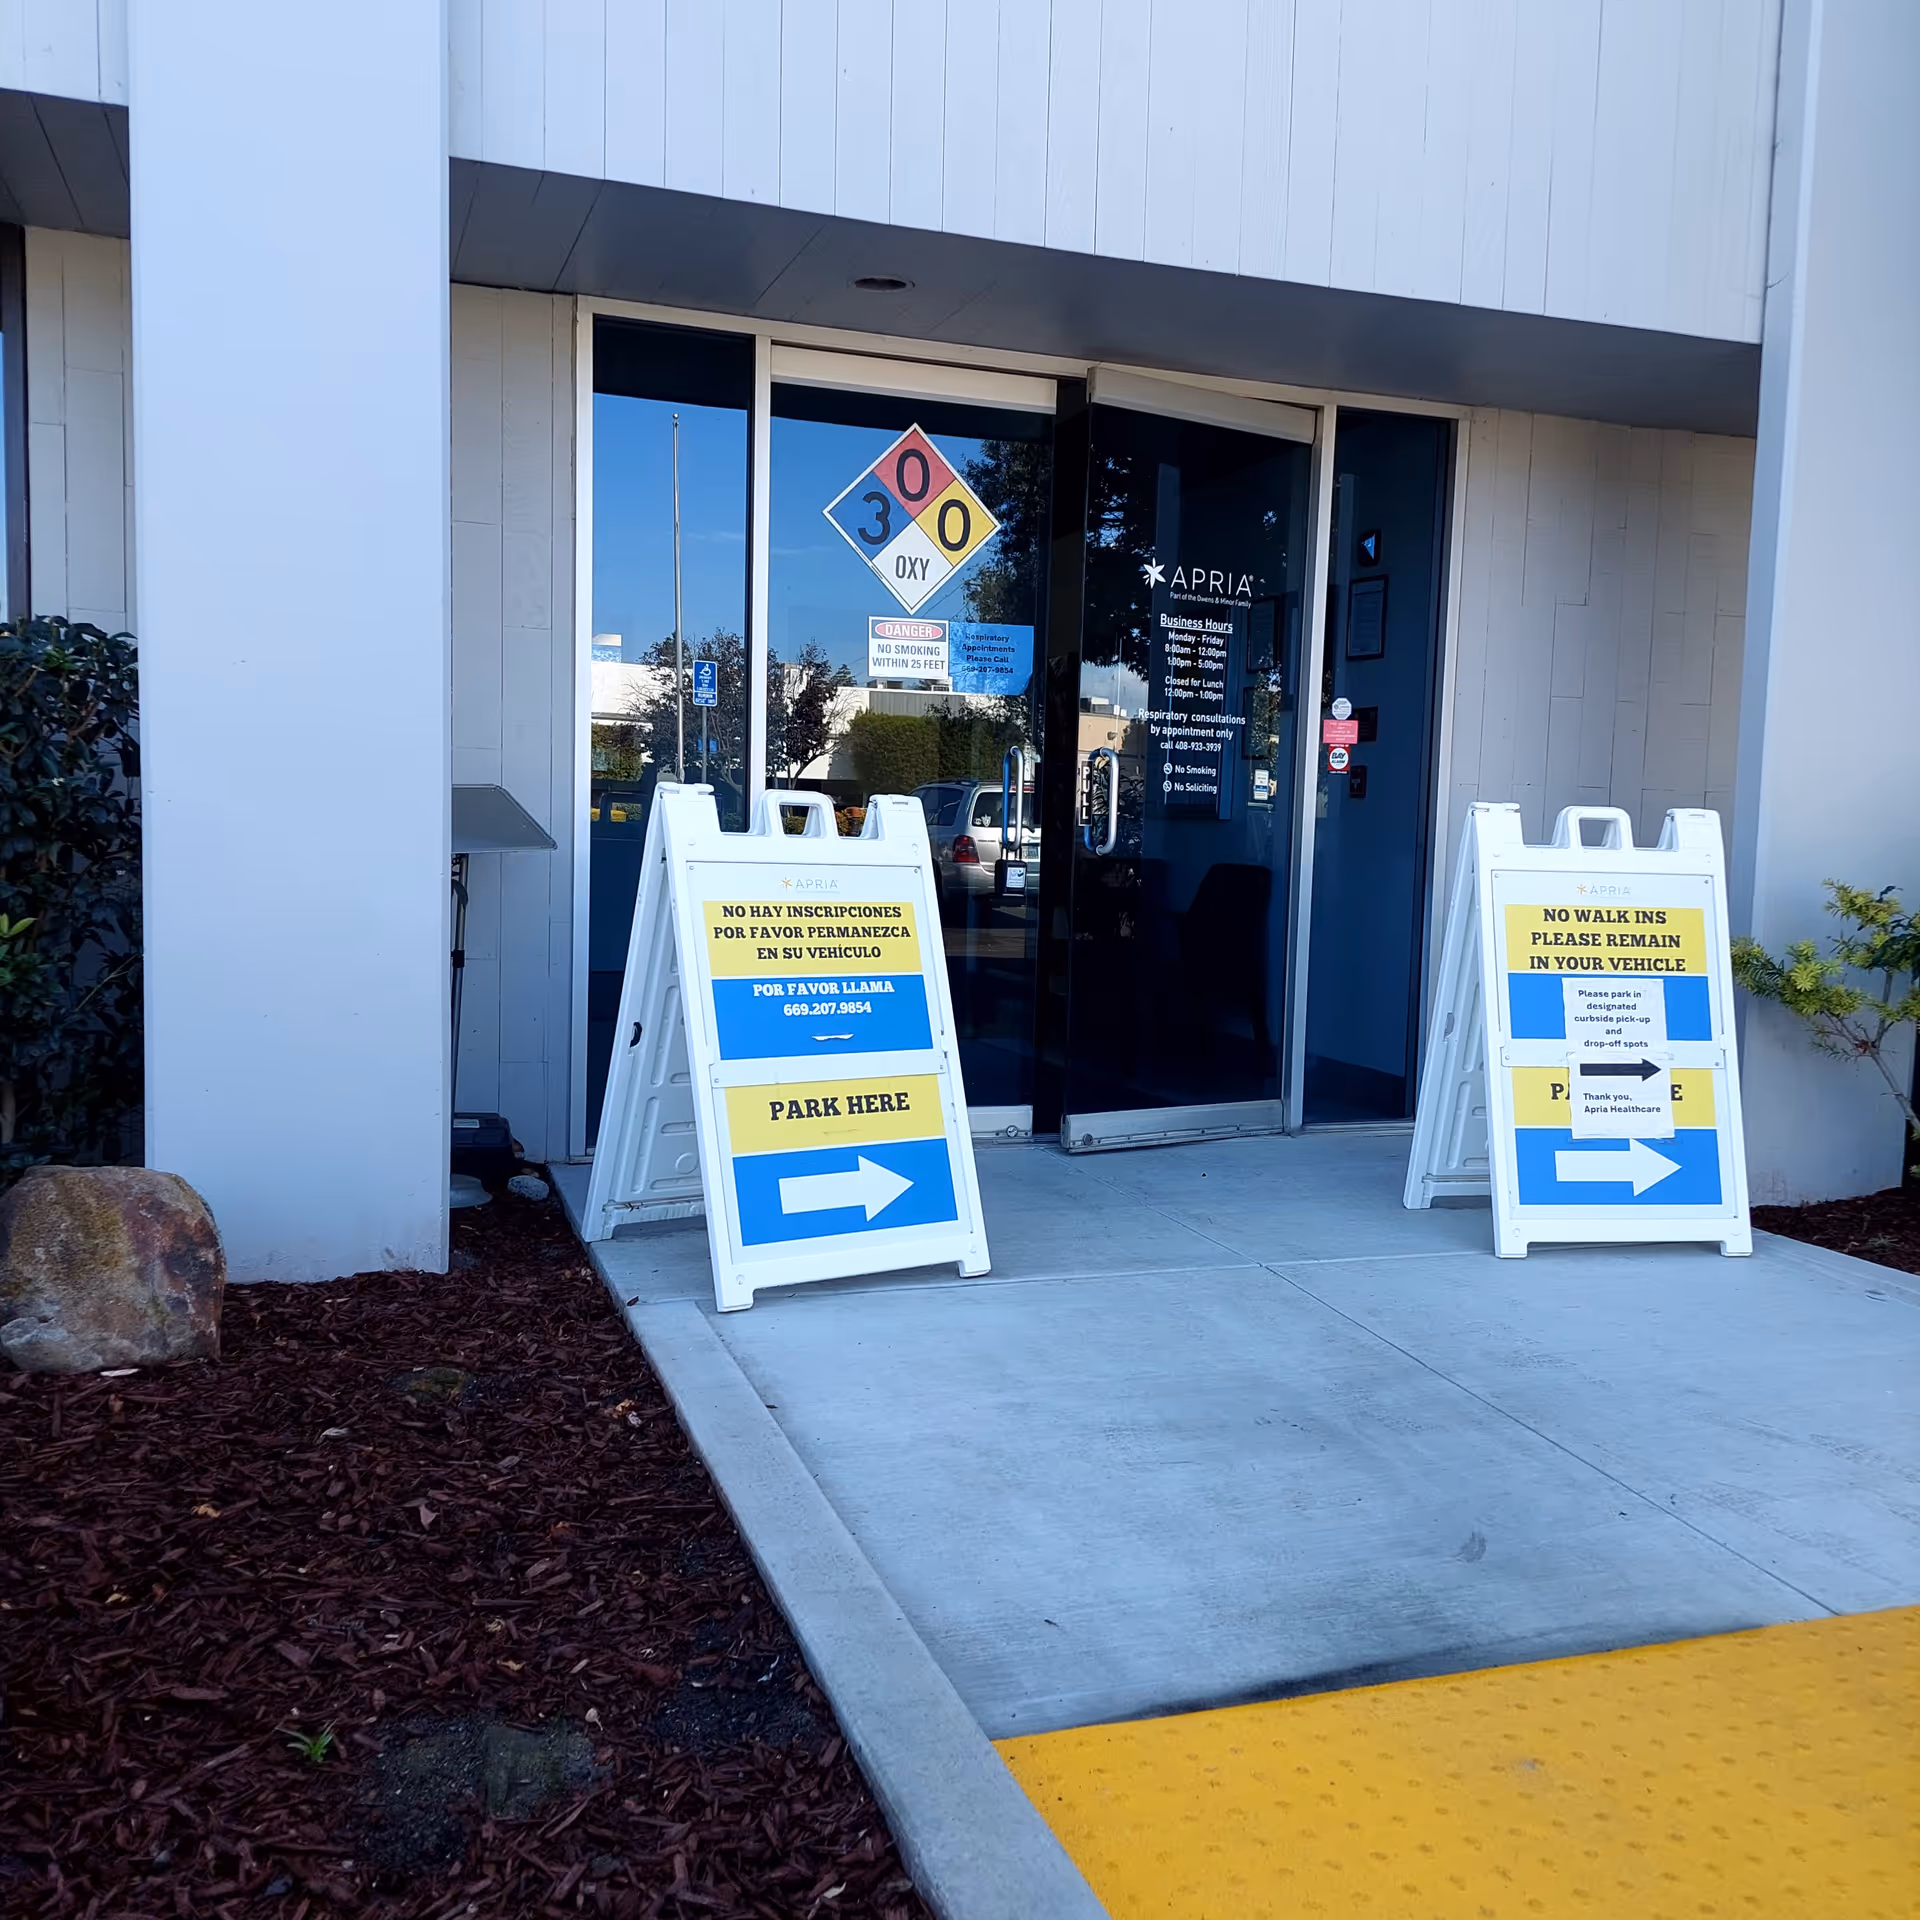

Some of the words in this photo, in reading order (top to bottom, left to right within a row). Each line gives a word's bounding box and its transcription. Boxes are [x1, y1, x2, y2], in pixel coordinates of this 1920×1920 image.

[896, 448, 930, 502] 0
[858, 491, 891, 546] 3
[938, 499, 970, 552] 0
[896, 555, 930, 581] OXY
[1170, 592, 1181, 600] Part
[1235, 599, 1252, 609] Family
[1160, 614, 1202, 628] Business
[1206, 618, 1233, 632] Hours
[886, 624, 932, 638] DANGER
[1168, 631, 1196, 644] Monday
[1202, 635, 1224, 646] Friday
[877, 644, 892, 655] NO
[894, 644, 940, 656] SMOKING
[962, 644, 1016, 653] Appointments
[1165, 644, 1191, 654] 8:00am
[1198, 647, 1226, 658] 12:00pm
[872, 656, 908, 668] WITHIN
[910, 658, 922, 669] 25
[924, 659, 946, 670] FEET
[1167, 657, 1192, 668] 1:00pm
[1198, 660, 1224, 671] 5:00pm
[1165, 676, 1189, 686] Closed
[1190, 678, 1200, 686] for
[1202, 679, 1223, 688] Lunch
[1164, 688, 1194, 699] 12:00pm
[1200, 690, 1223, 701] 1:00pm
[1138, 708, 1188, 723] Respiratory
[1191, 713, 1246, 724] consultations
[1150, 724, 1160, 736] by
[1162, 726, 1214, 737] appointment
[1216, 728, 1234, 740] only
[1160, 741, 1173, 749] call
[1175, 741, 1221, 752] 408-933-3939
[1175, 765, 1185, 774] No
[1186, 766, 1216, 777] Smoking
[1082, 766, 1090, 819] PULL
[1174, 783, 1184, 791] No
[1186, 783, 1217, 794] Soliciting
[722, 905, 746, 918] NO
[750, 905, 782, 918] HAY
[786, 906, 902, 918] INSCRIPCIONES
[1543, 908, 1570, 922] NO
[1574, 909, 1630, 924] WALK
[1634, 910, 1666, 924] INS
[714, 926, 746, 939] POR
[750, 926, 803, 938] FAVOR
[807, 926, 911, 938] PERMANEZCA
[1531, 932, 1601, 946] PLEASE
[1606, 934, 1681, 948] REMAIN
[757, 948, 778, 960] EN
[782, 947, 802, 959] SU
[807, 944, 881, 958] VEHÍCULO
[1529, 956, 1550, 969] IN
[1554, 957, 1604, 970] YOUR
[1608, 958, 1686, 972] VEHICLE
[753, 984, 784, 997] POR
[787, 982, 839, 996] FAVOR
[842, 980, 895, 994] LLAMA
[1578, 990, 1609, 998] Please
[1611, 990, 1631, 1000] park
[1633, 990, 1642, 998] in
[783, 1001, 872, 1016] 669.207.9854
[1586, 1002, 1637, 1012] designated
[1574, 1015, 1614, 1023] curbside
[1616, 1015, 1651, 1025] pick-up
[1605, 1027, 1622, 1035] and
[1584, 1040, 1622, 1050] drop-off
[1623, 1040, 1649, 1050] spots
[1583, 1093, 1611, 1101] Thank
[1613, 1094, 1632, 1103] you,
[769, 1097, 841, 1121] PARK
[846, 1092, 910, 1114] HERE
[1584, 1105, 1609, 1114] Apria
[1610, 1105, 1661, 1114] Healthcare
